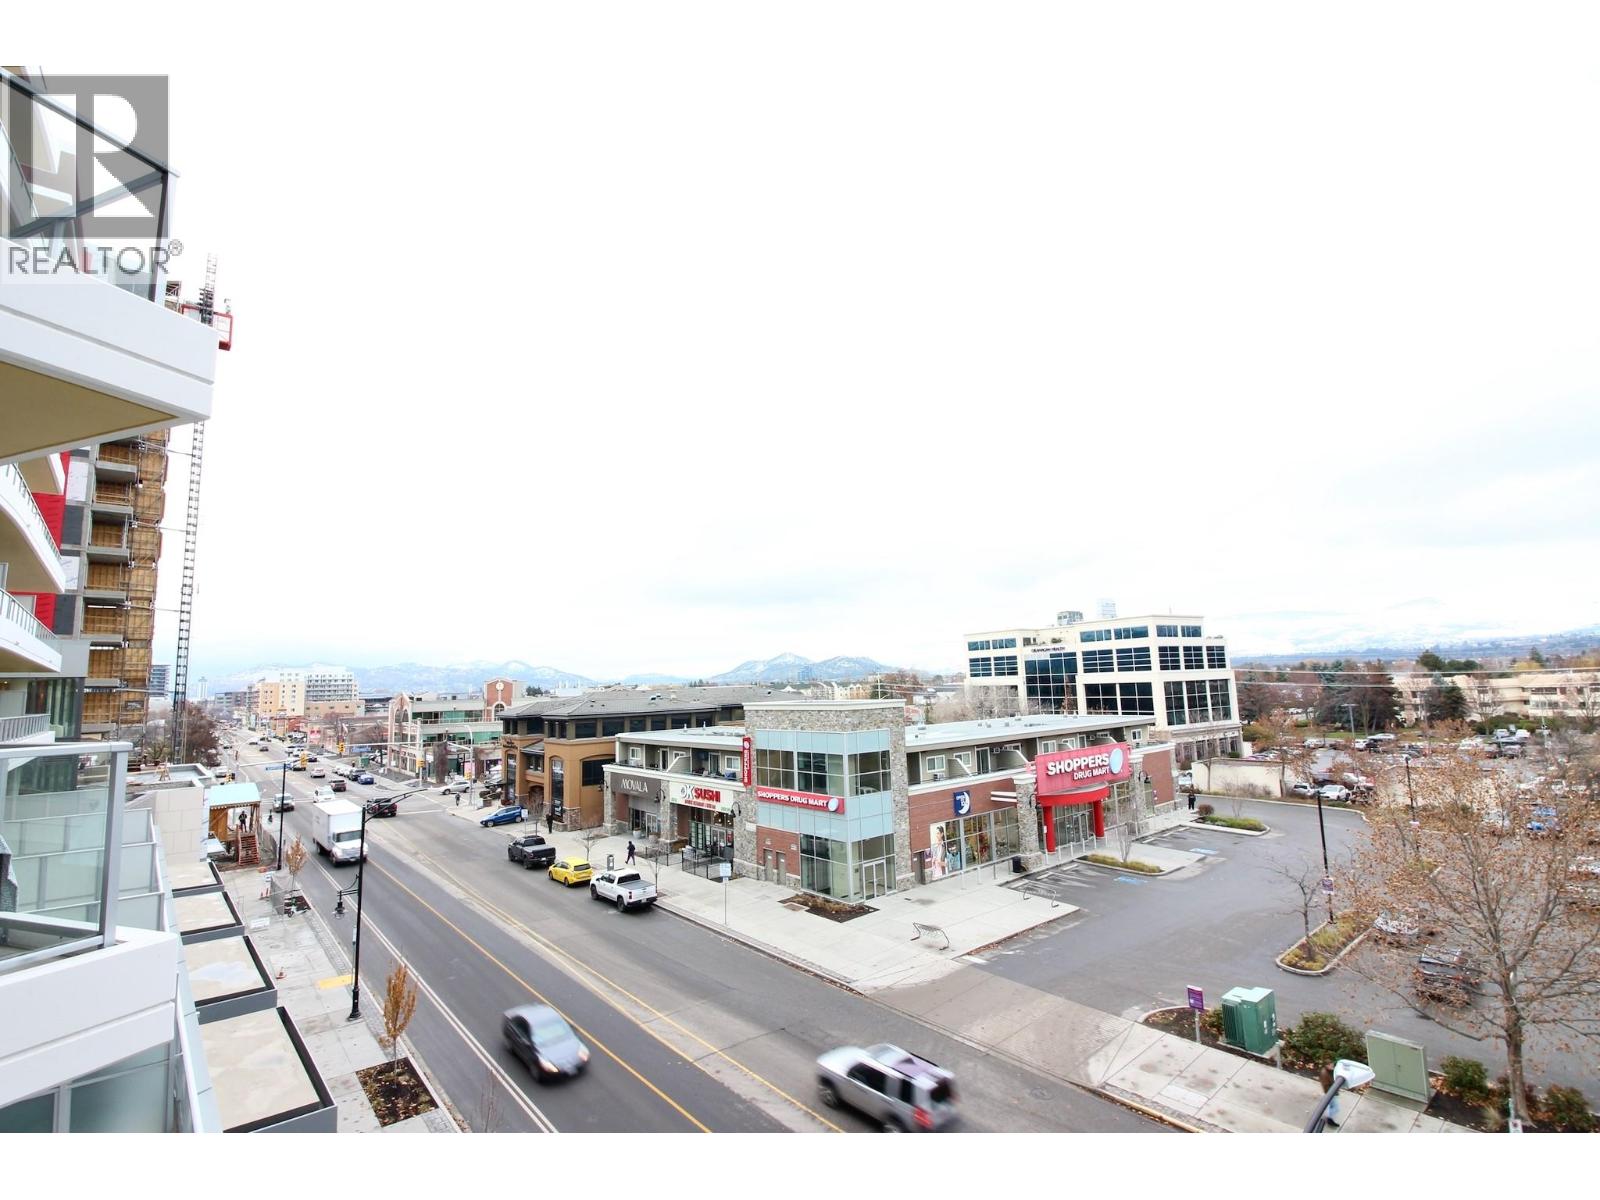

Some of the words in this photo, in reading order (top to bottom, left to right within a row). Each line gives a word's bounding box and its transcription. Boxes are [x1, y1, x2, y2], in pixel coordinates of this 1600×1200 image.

[1047, 753, 1109, 775] SHOPPERS
[1073, 769, 1093, 780] DRUG
[1093, 766, 1110, 777] MART
[694, 787, 721, 802] SUSHI
[757, 791, 790, 802] SHOPPERS
[790, 795, 808, 804] DRUG
[808, 798, 828, 807] MART
